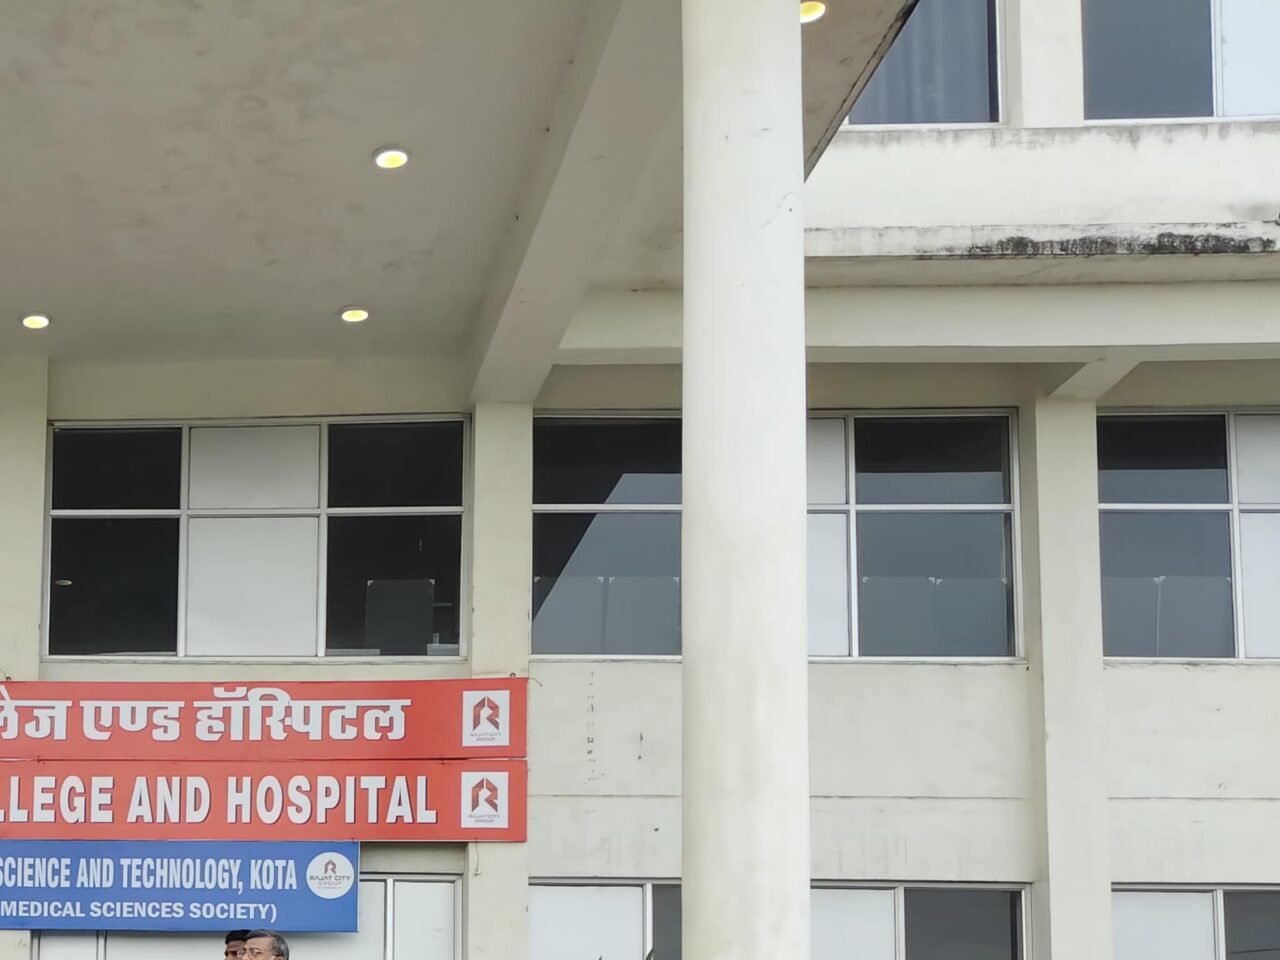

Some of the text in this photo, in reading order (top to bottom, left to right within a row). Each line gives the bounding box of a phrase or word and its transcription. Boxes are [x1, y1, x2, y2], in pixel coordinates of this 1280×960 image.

[79, 700, 185, 741] एण्ड
[126, 776, 211, 823] AND
[226, 775, 438, 824] HOSPITAL
[76, 857, 114, 889] AND
[120, 857, 243, 895] TECHNOLOGY,
[250, 859, 298, 890] KOTA
[0, 900, 86, 918] MEDICAL
[90, 901, 185, 919] SCIENCES
[188, 902, 278, 924] SOCIETY)
